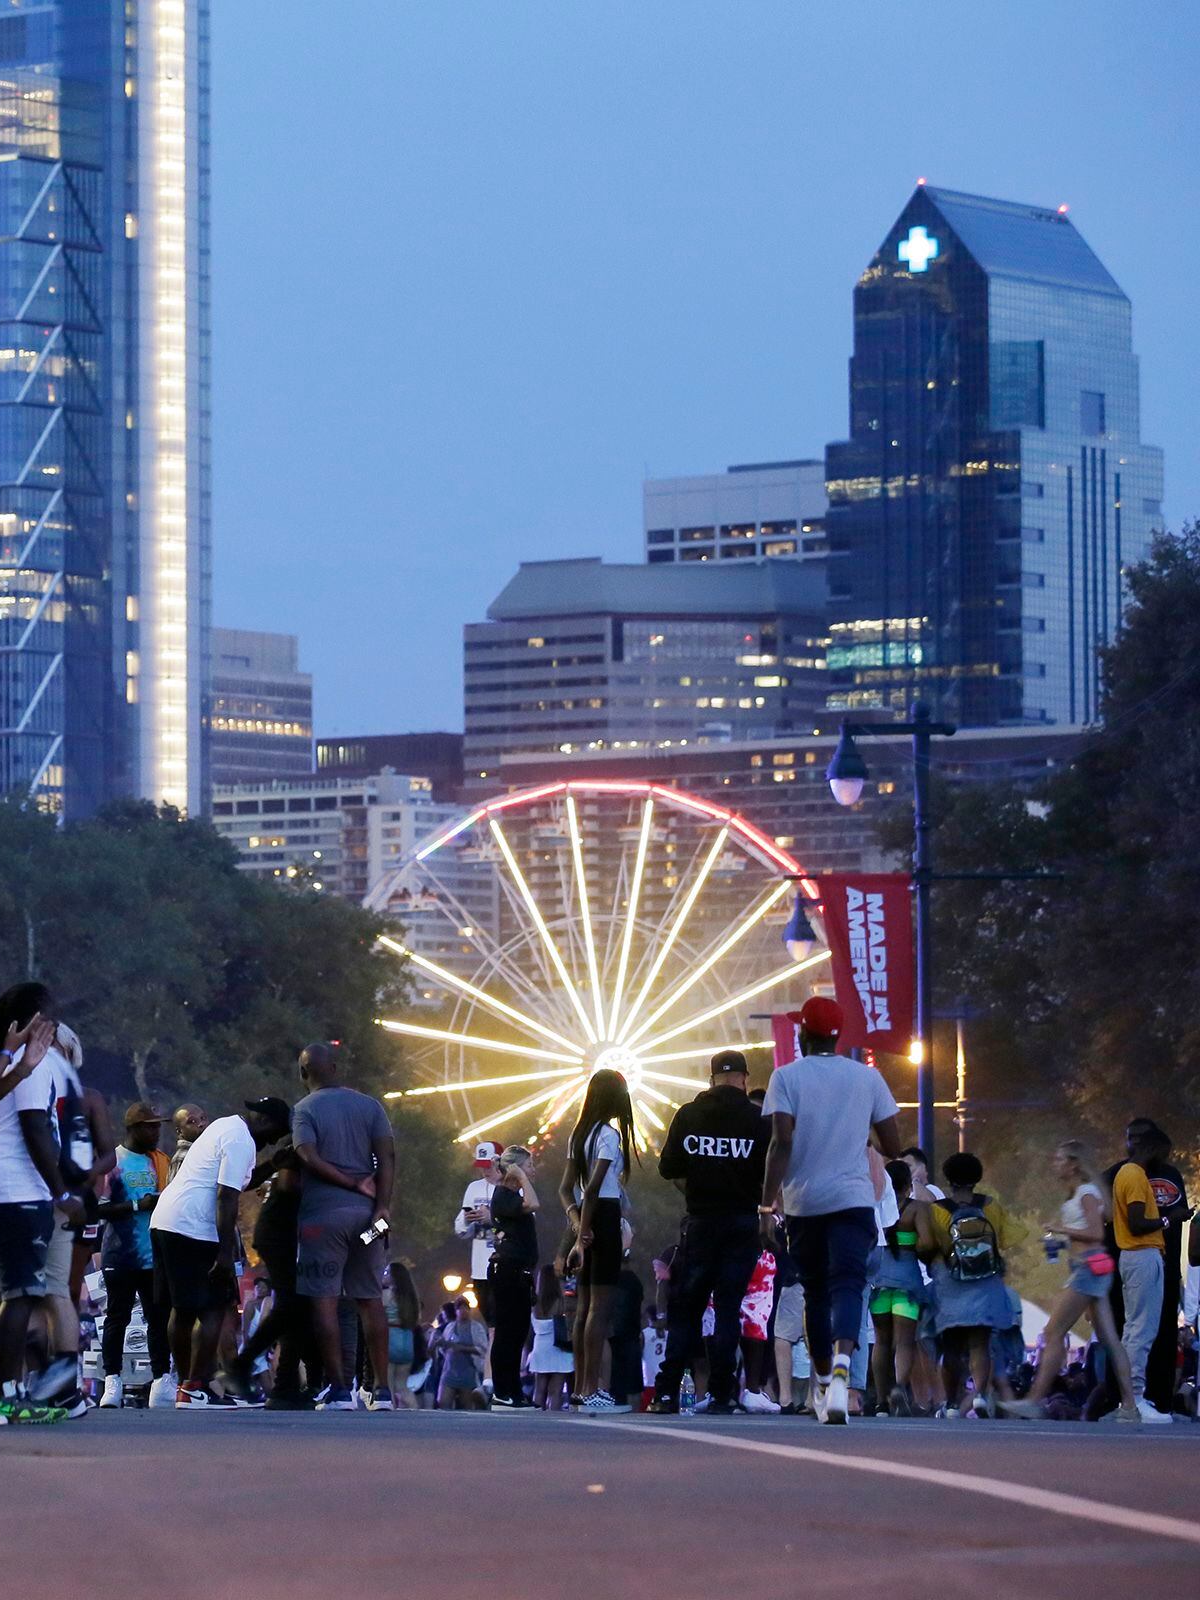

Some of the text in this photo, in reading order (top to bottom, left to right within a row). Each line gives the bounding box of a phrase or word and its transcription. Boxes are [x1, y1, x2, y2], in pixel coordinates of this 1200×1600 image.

[846, 886, 877, 1033] AMERICA
[866, 893, 892, 1030] MADE IN
[683, 1134, 755, 1159] CREW
